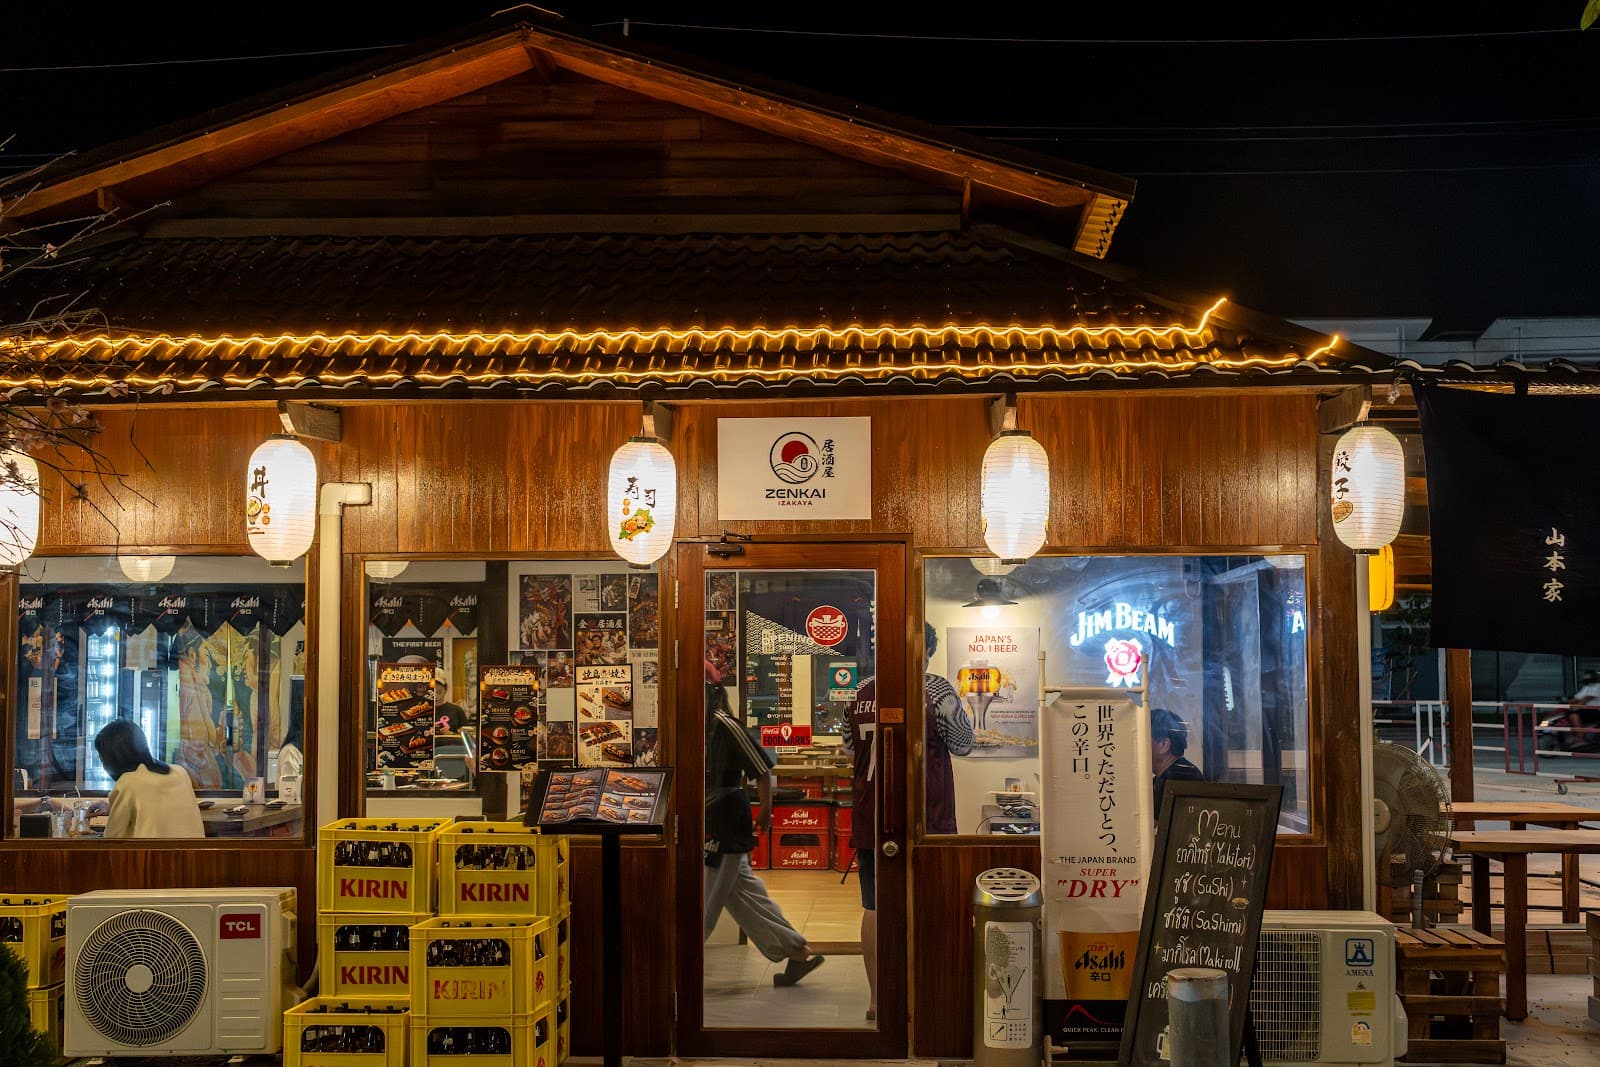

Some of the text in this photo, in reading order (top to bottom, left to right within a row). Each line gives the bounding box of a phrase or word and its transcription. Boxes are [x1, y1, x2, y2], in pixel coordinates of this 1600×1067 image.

[821, 439, 835, 478] 居酒屋
[624, 476, 656, 508] 寿司
[765, 488, 826, 499] ZENKAI
[1542, 527, 1567, 603] 山本家
[86, 596, 114, 609] Asahi
[158, 596, 187, 609] Asahi
[230, 595, 260, 608] Asahi
[374, 595, 403, 608] Asahi
[449, 594, 478, 607] Asahi
[1070, 602, 1175, 648] JIM BEAM
[973, 634, 1013, 644] JAPAN'S
[968, 644, 985, 653] NO.
[994, 644, 1018, 653] BEER
[968, 671, 990, 681] Asahi
[1071, 704, 1091, 780] この辛口。
[1096, 704, 1117, 853] 世界でただひとつ、
[790, 809, 809, 818] Asahi
[790, 849, 809, 859] Asahi
[1059, 856, 1137, 864] THE JAPAN BRAND
[1079, 868, 1117, 877] SUPER
[340, 878, 408, 899] KIRIN
[461, 882, 529, 902] KIRIN
[225, 921, 256, 931] TCL
[1074, 949, 1125, 970] Asahi
[341, 965, 409, 985] KIRIN
[1089, 971, 1111, 982] 辛口
[1345, 969, 1374, 977] AMENA
[434, 979, 506, 1000] KIRIN
